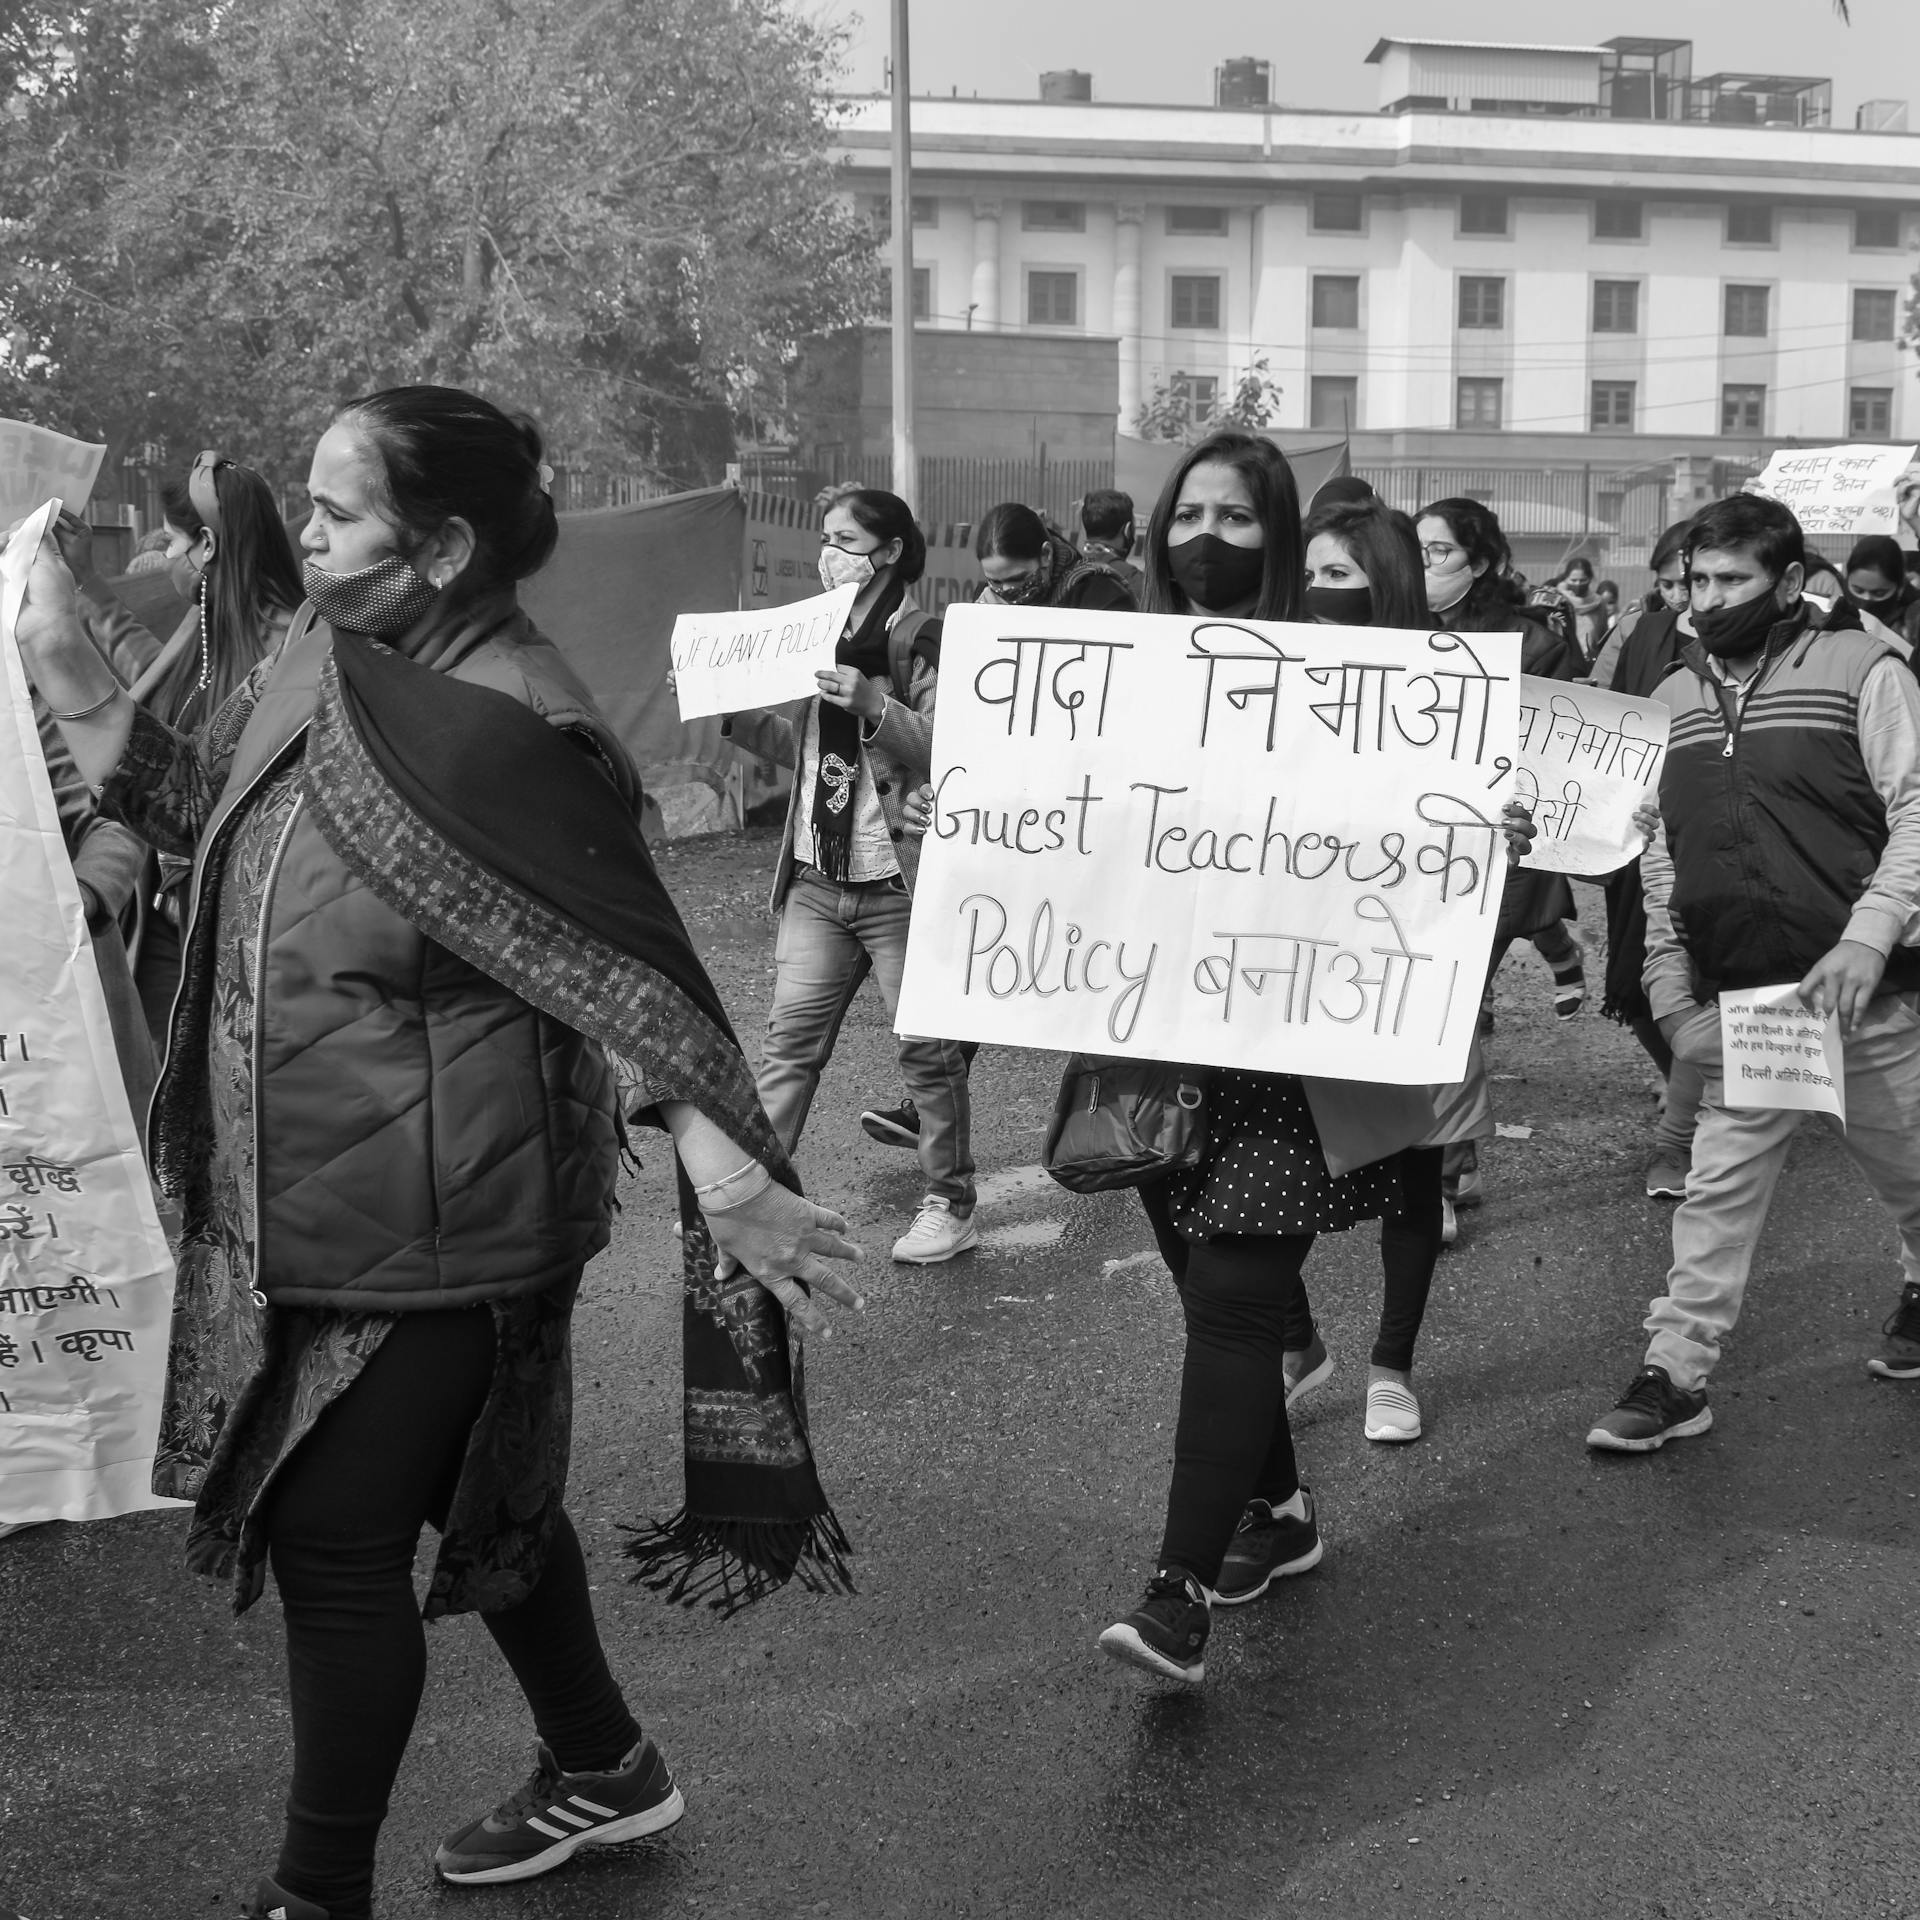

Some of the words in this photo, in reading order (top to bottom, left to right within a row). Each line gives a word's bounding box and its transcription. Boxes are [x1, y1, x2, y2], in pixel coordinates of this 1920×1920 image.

[708, 629, 772, 669] WANT
[776, 608, 841, 659] POLICY
[973, 637, 1134, 741] वादा
[1541, 694, 1664, 786] निर्माता
[930, 766, 1104, 855] Guest
[1130, 783, 1406, 889] Teachers
[1415, 792, 1508, 915] को
[958, 893, 1158, 1043] Policy
[1729, 1038, 1749, 1050] और
[1741, 1063, 1772, 1081] दिल्ली
[2, 1155, 82, 1195] वृद्धि
[55, 1329, 134, 1362] कृपा
